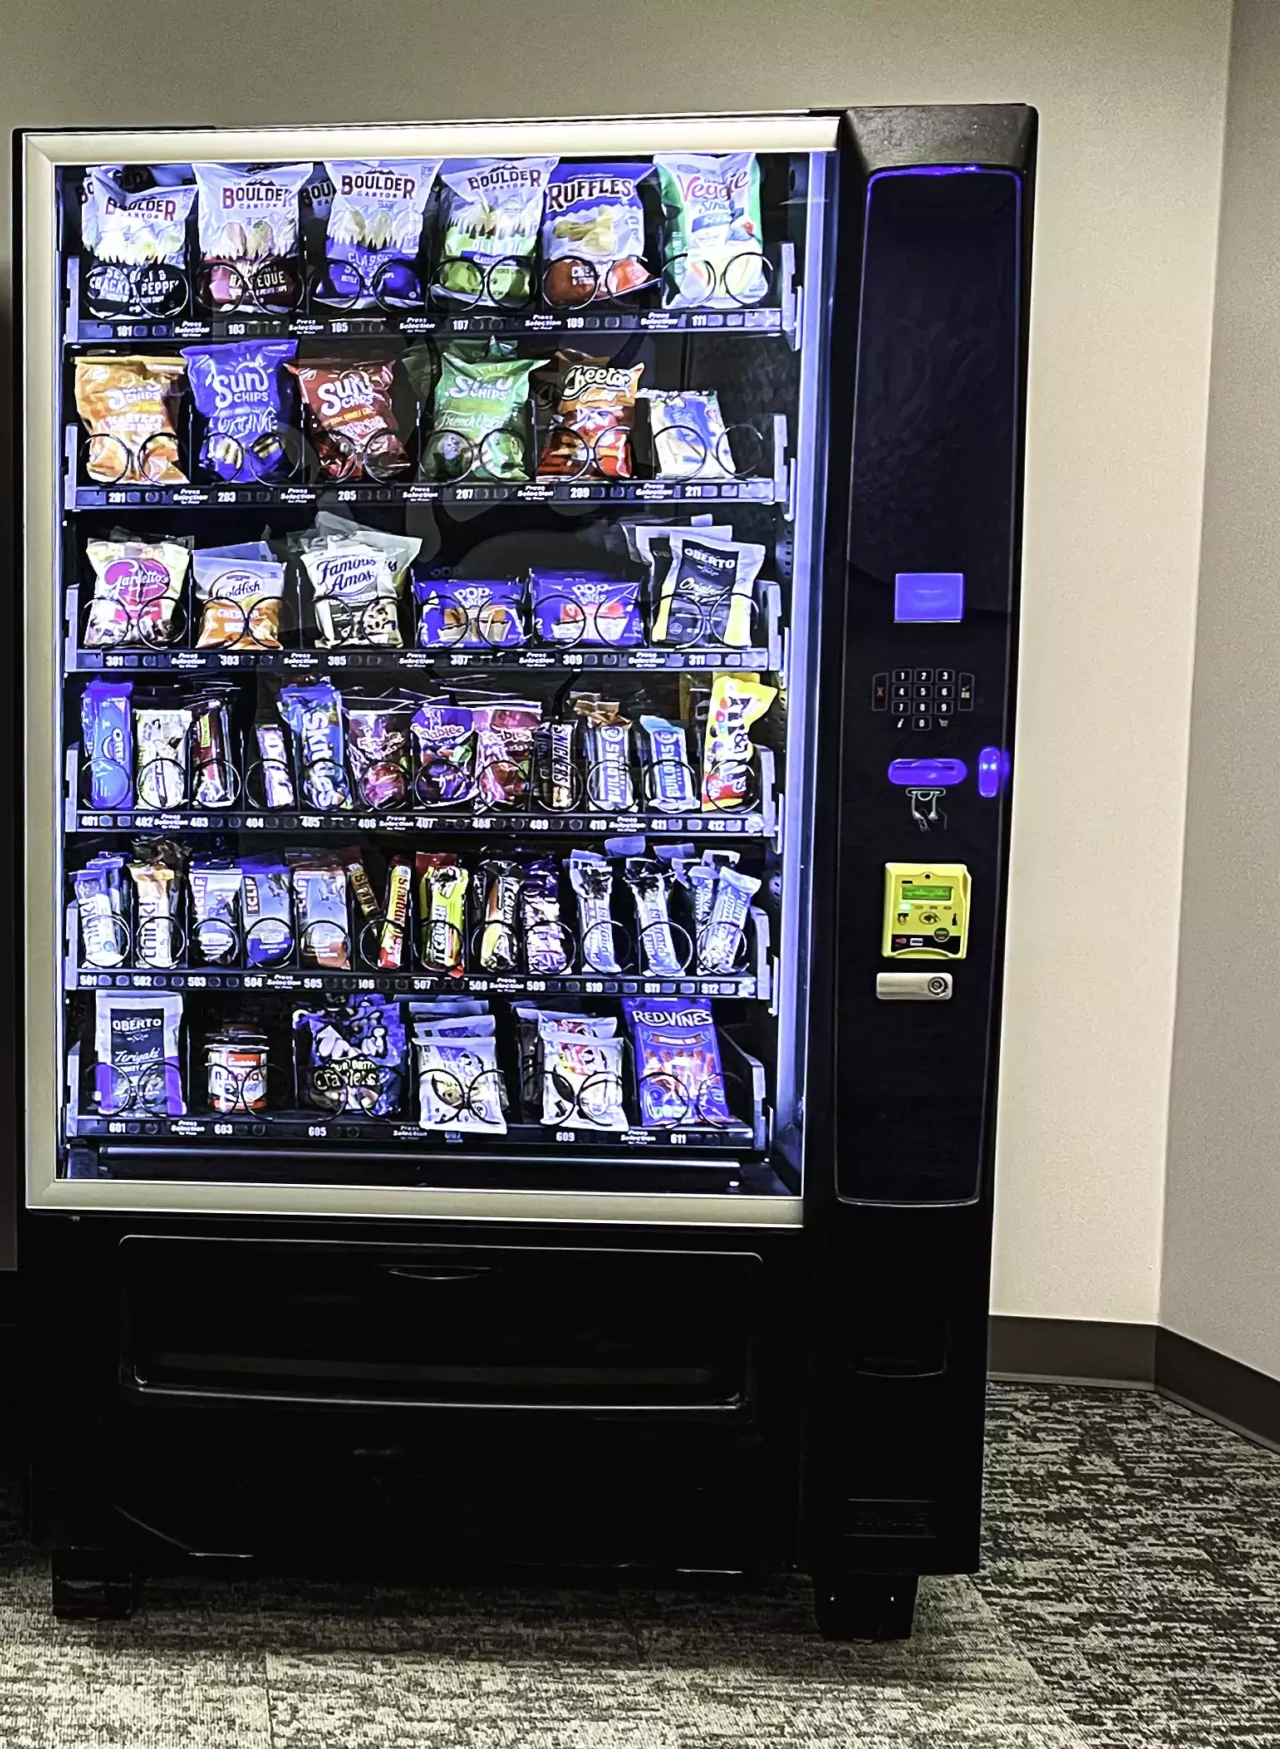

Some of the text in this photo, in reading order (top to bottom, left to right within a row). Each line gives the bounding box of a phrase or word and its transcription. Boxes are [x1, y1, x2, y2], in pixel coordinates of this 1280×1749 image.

[470, 169, 541, 190] BOULDER
[342, 174, 415, 199] BOULDER
[677, 169, 749, 202] Veggie
[222, 187, 294, 209] BOULDER
[547, 178, 633, 212] RUFFLES
[453, 320, 468, 330] 107
[567, 317, 584, 328] 109
[692, 316, 707, 326] 111
[117, 325, 133, 337] 101
[228, 325, 245, 335] 103
[331, 323, 348, 333] 105
[214, 365, 269, 408] Sun
[234, 391, 269, 403] CHIPS
[108, 491, 126, 503] 201
[218, 491, 236, 502] 203
[338, 490, 357, 501] 205
[456, 489, 473, 500] 207
[570, 488, 590, 499] 209
[685, 487, 701, 498] 211
[684, 547, 736, 569] OBERTO
[317, 559, 376, 585] Famous
[216, 580, 261, 598] Goldfish
[106, 656, 123, 667] 301
[221, 656, 239, 666] 303
[328, 656, 346, 667] 305
[450, 656, 470, 666] 307
[563, 655, 582, 666] 309
[689, 655, 705, 666] 311
[82, 816, 98, 827] 401
[135, 816, 153, 827] 402
[190, 817, 208, 828] 403
[246, 818, 264, 829] 404
[302, 817, 320, 828] 405
[358, 818, 376, 829] 406
[416, 818, 434, 829] 407
[472, 818, 490, 829] 408
[530, 819, 548, 830] 409
[589, 820, 607, 830] 410
[651, 820, 666, 830] 411
[708, 819, 724, 830] 412
[80, 976, 97, 987] 501
[133, 976, 151, 987] 502
[188, 976, 206, 987] 503
[244, 976, 263, 987] 504
[304, 978, 322, 989] 505
[414, 979, 432, 989] 507
[469, 980, 487, 991] 508
[526, 980, 545, 991] 509
[586, 982, 603, 993] 510
[645, 983, 660, 994] 511
[702, 983, 719, 994] 512
[112, 1017, 161, 1031] OBERTO
[114, 1047, 161, 1064] Teriyaki
[109, 1123, 126, 1134] 601
[215, 1124, 233, 1135] 603
[309, 1126, 327, 1137] 605
[556, 1131, 574, 1142] 609
[671, 1133, 686, 1144] 611
